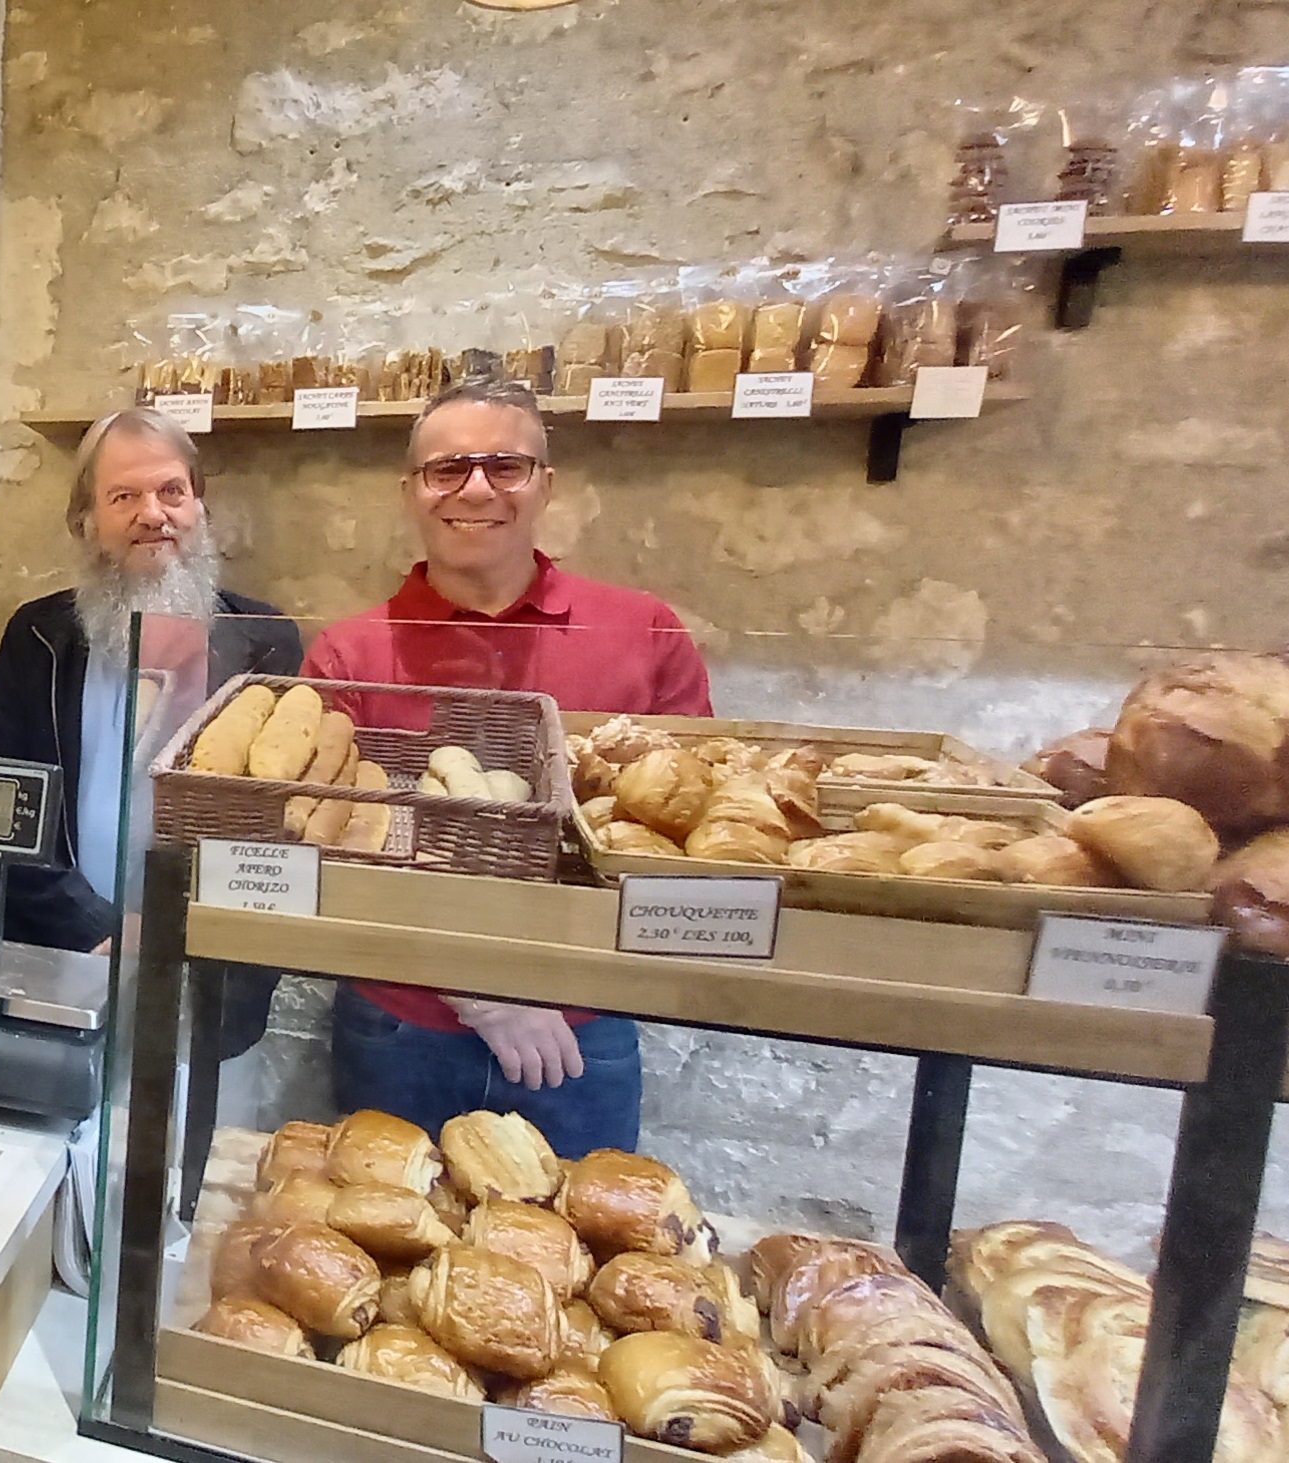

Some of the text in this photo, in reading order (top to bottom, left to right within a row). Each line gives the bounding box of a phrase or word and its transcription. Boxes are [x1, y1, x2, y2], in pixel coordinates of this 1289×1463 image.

[230, 845, 290, 859] FICELLE
[235, 863, 282, 876] APERO
[228, 880, 290, 894] CHORIZO
[629, 905, 759, 921] CHOUQUETTE
[681, 930, 717, 942] LES
[527, 1417, 572, 1433] PAIN
[494, 1430, 615, 1459] AU CHOCOLAT
